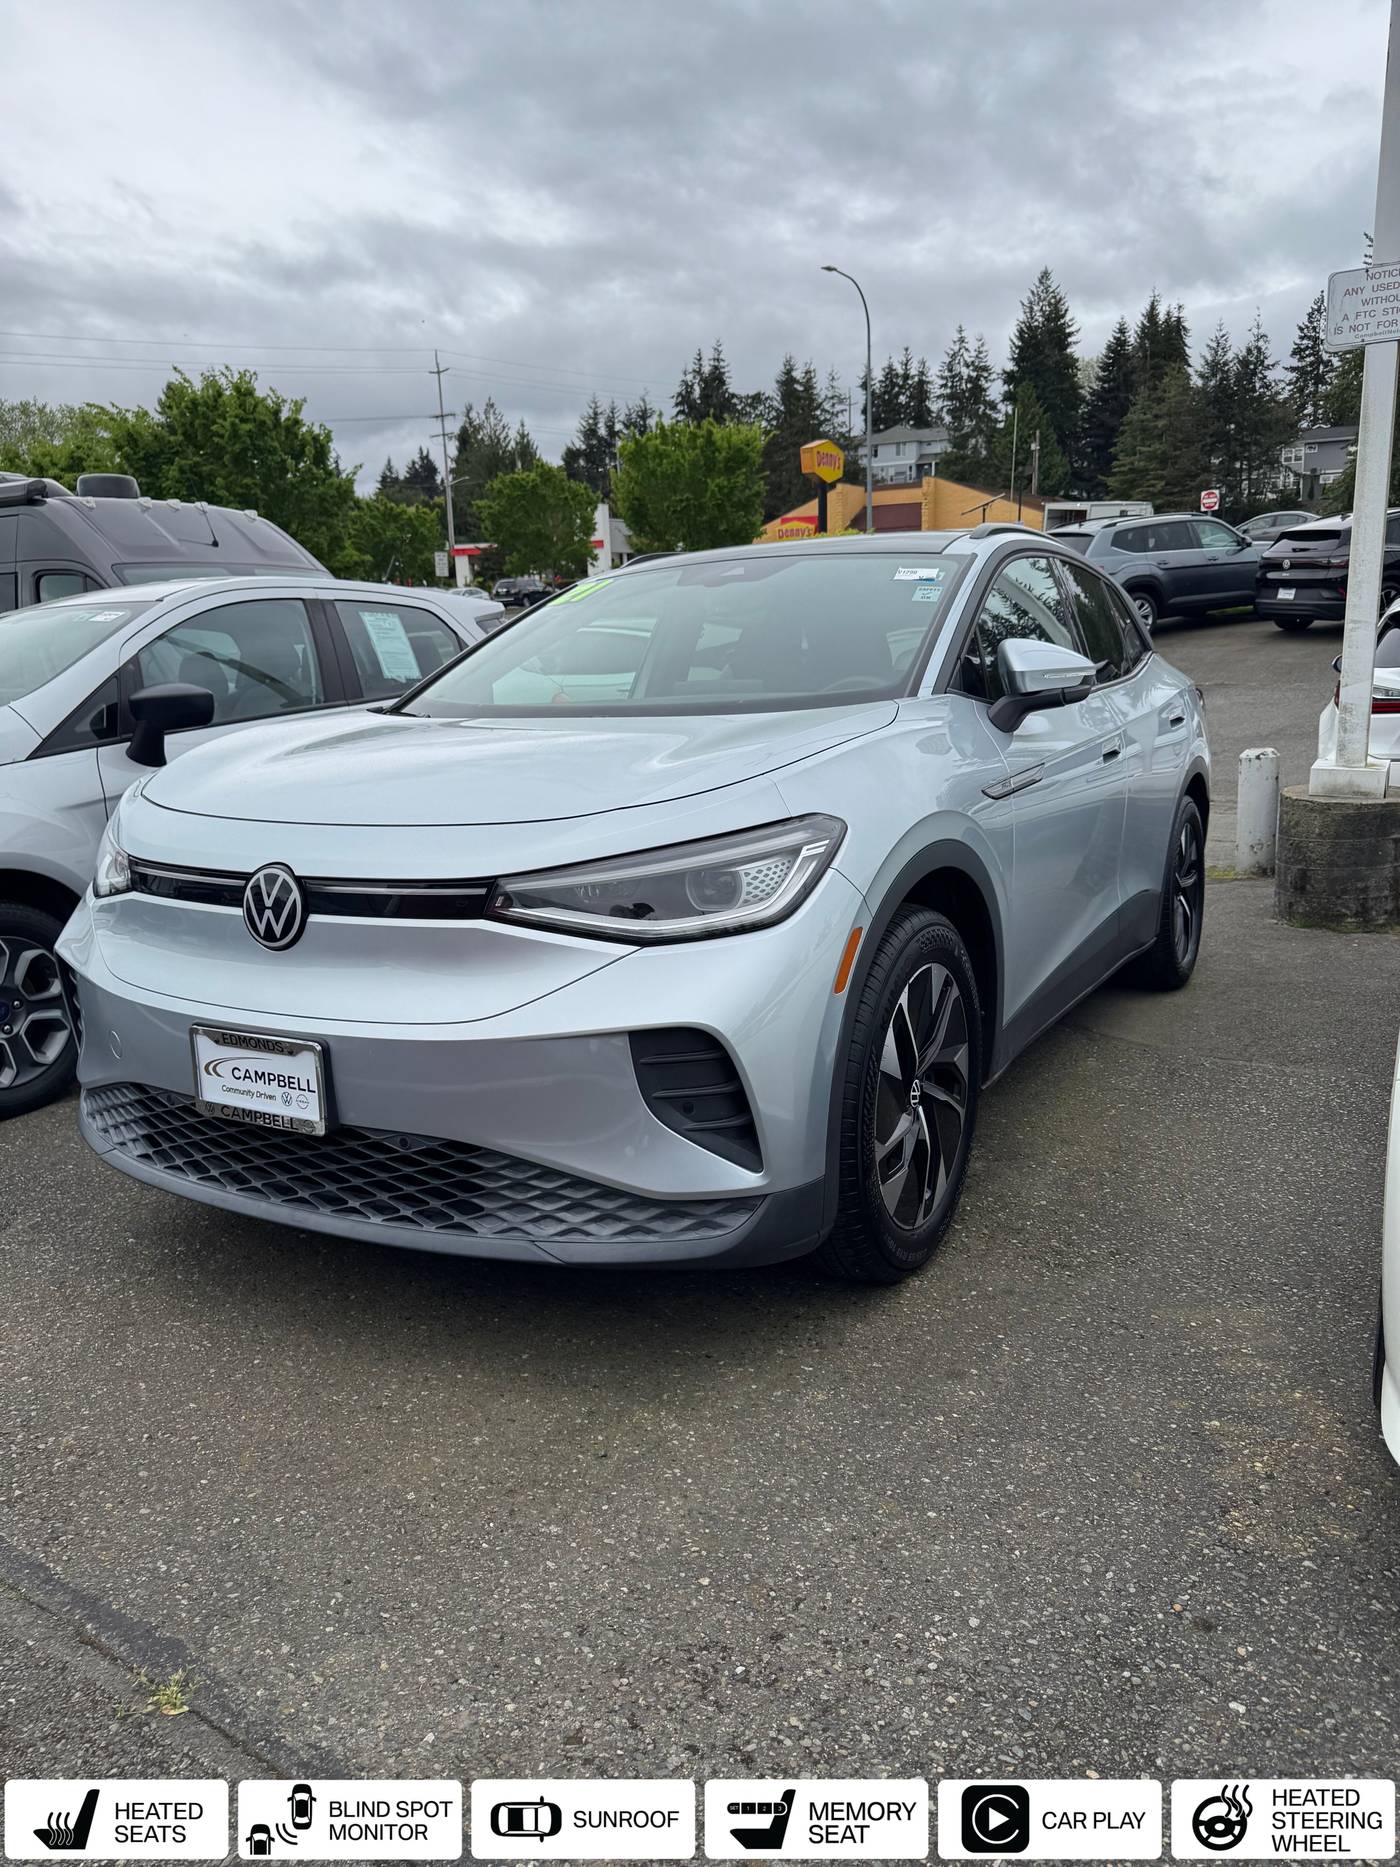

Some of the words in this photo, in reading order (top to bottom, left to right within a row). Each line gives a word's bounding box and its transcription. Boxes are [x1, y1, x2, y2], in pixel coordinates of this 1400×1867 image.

[1366, 269, 1400, 281] NOTIC
[1344, 286, 1365, 297] ANY
[1372, 281, 1400, 293] USED
[1342, 313, 1350, 322] A
[1355, 309, 1376, 321] FTC
[1382, 306, 1400, 316] STI
[1334, 326, 1343, 335] IS
[1349, 322, 1371, 333] NOT
[1377, 319, 1398, 330] FOR
[816, 450, 841, 472] Denny's
[777, 526, 813, 540] Denny's
[221, 1032, 285, 1053] EDMONDS
[231, 1066, 316, 1093] CAMPBELL
[221, 1084, 255, 1099] Community
[256, 1090, 277, 1101] Driven
[220, 1104, 299, 1130] CAMPBELL
